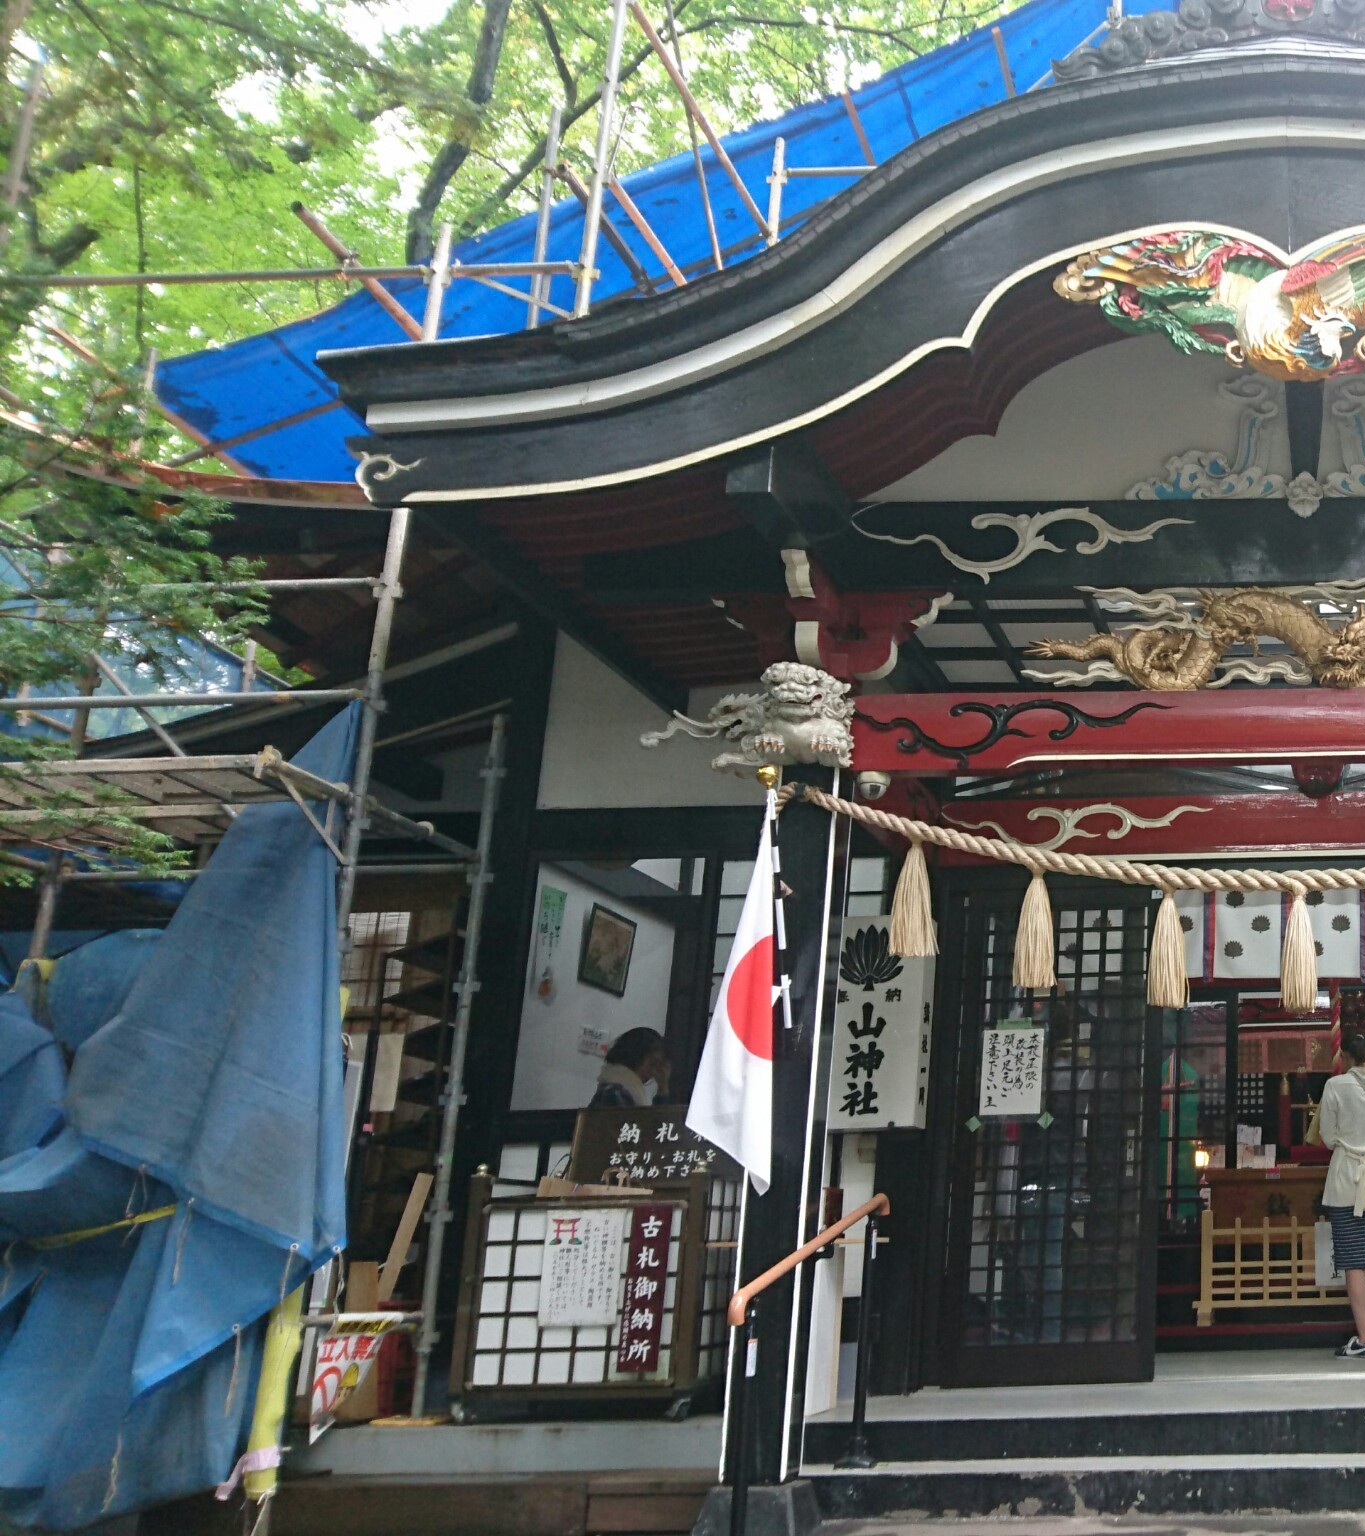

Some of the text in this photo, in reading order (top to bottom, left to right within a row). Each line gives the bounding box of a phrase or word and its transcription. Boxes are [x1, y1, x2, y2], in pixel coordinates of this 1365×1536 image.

[839, 1001, 886, 1117] 山神社
[627, 1215, 662, 1364] 古札御納所
